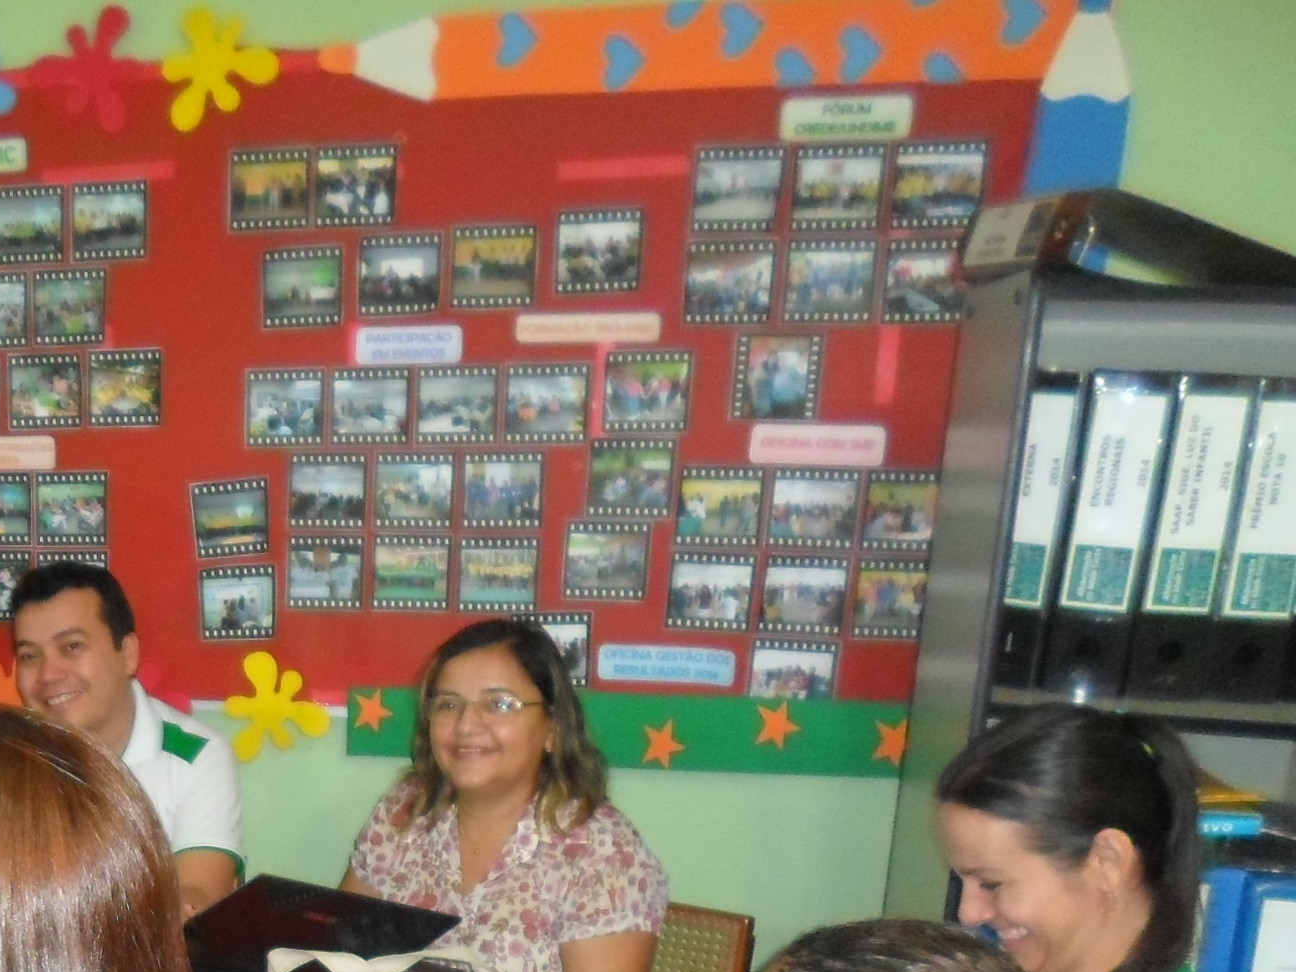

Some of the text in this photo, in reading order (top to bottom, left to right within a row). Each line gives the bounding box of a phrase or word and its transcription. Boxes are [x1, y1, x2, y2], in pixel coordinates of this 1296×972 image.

[366, 331, 452, 344] PARTICIPAÇÃO
[1021, 443, 1037, 497] EXTERNA
[1090, 434, 1113, 507] ENCONTROS
[1105, 436, 1126, 507] REGIONAIS
[603, 649, 652, 661] OFICINA
[655, 648, 703, 662] GESTÃO
[614, 664, 691, 677] RESULTADOS
